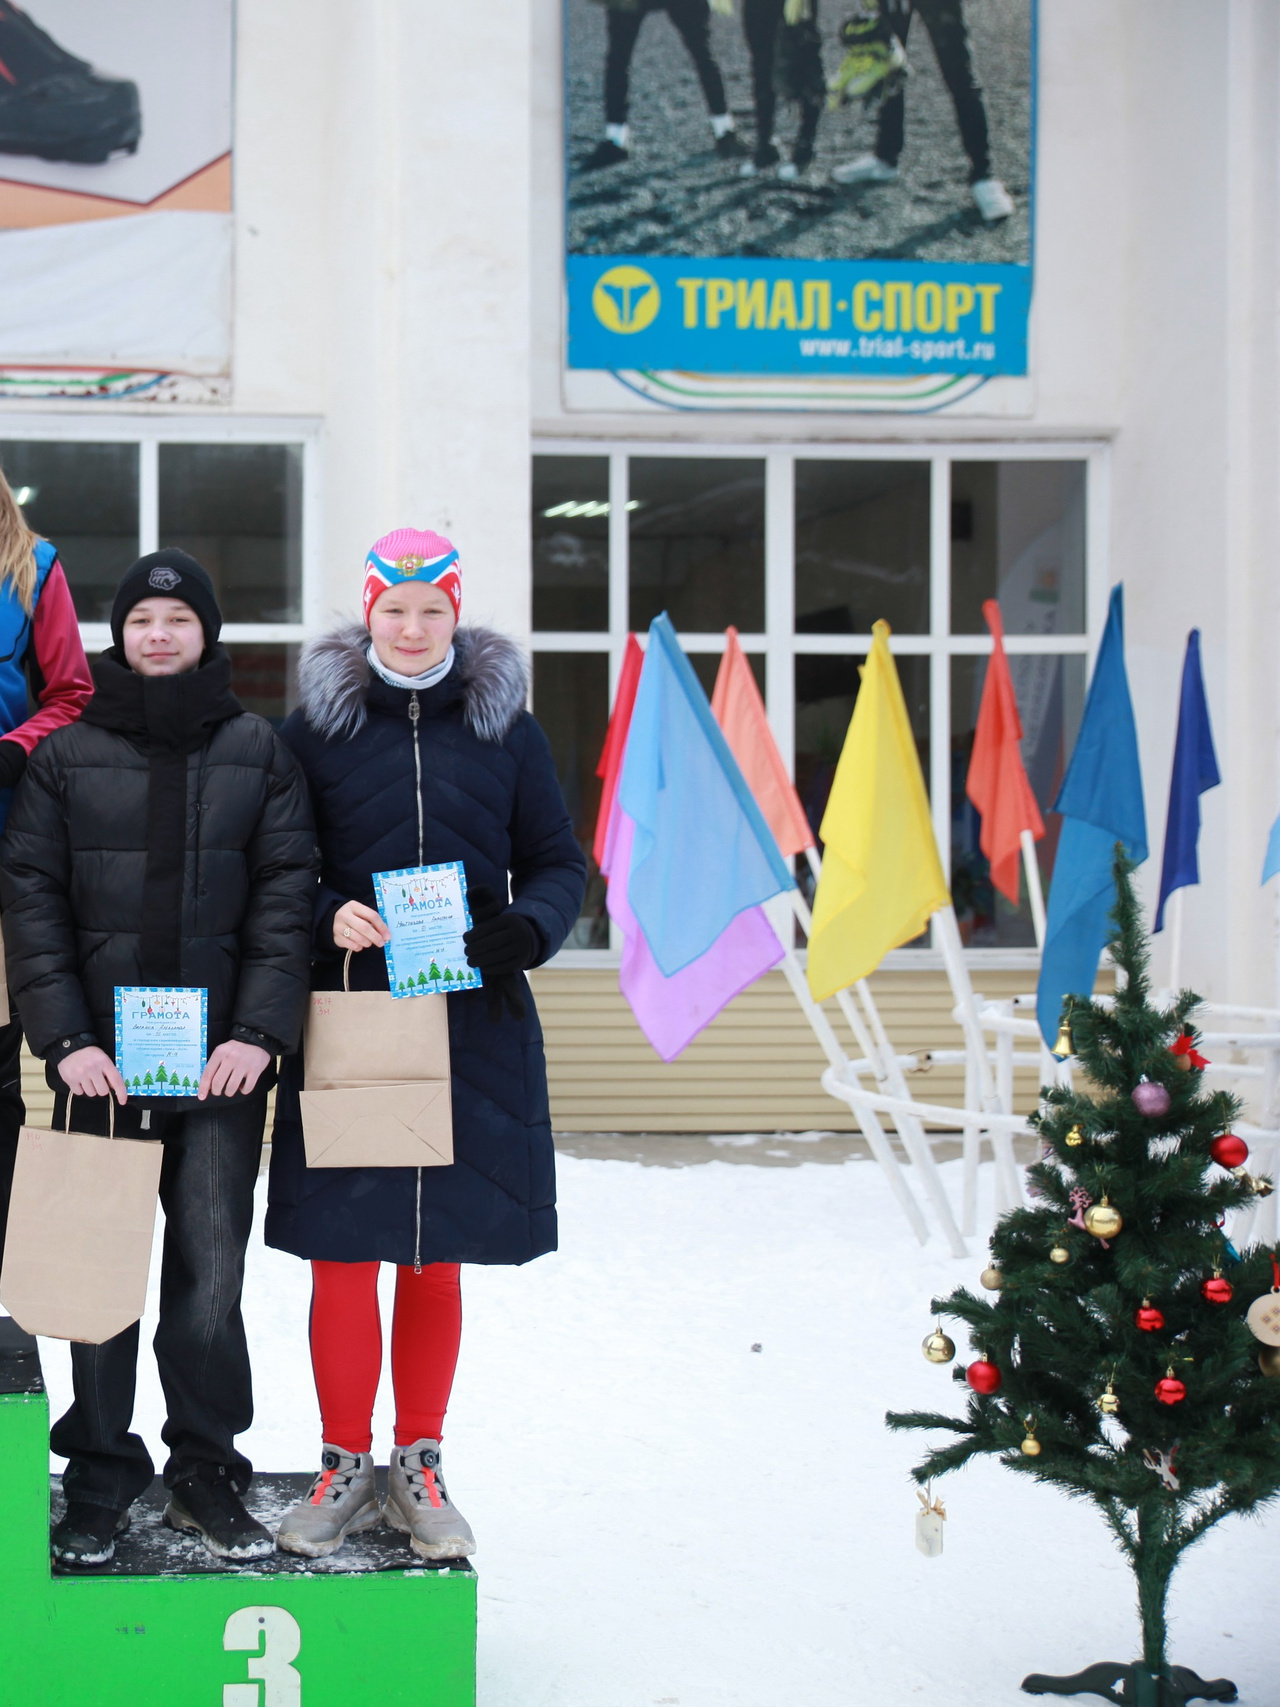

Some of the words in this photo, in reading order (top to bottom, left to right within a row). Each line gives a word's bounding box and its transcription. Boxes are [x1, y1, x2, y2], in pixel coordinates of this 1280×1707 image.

[799, 336, 995, 362] www.trial-sport.ru
[394, 897, 452, 914] ГРАМОТА
[132, 1011, 189, 1019] ГРАМОТА
[222, 1605, 301, 1707] 3
